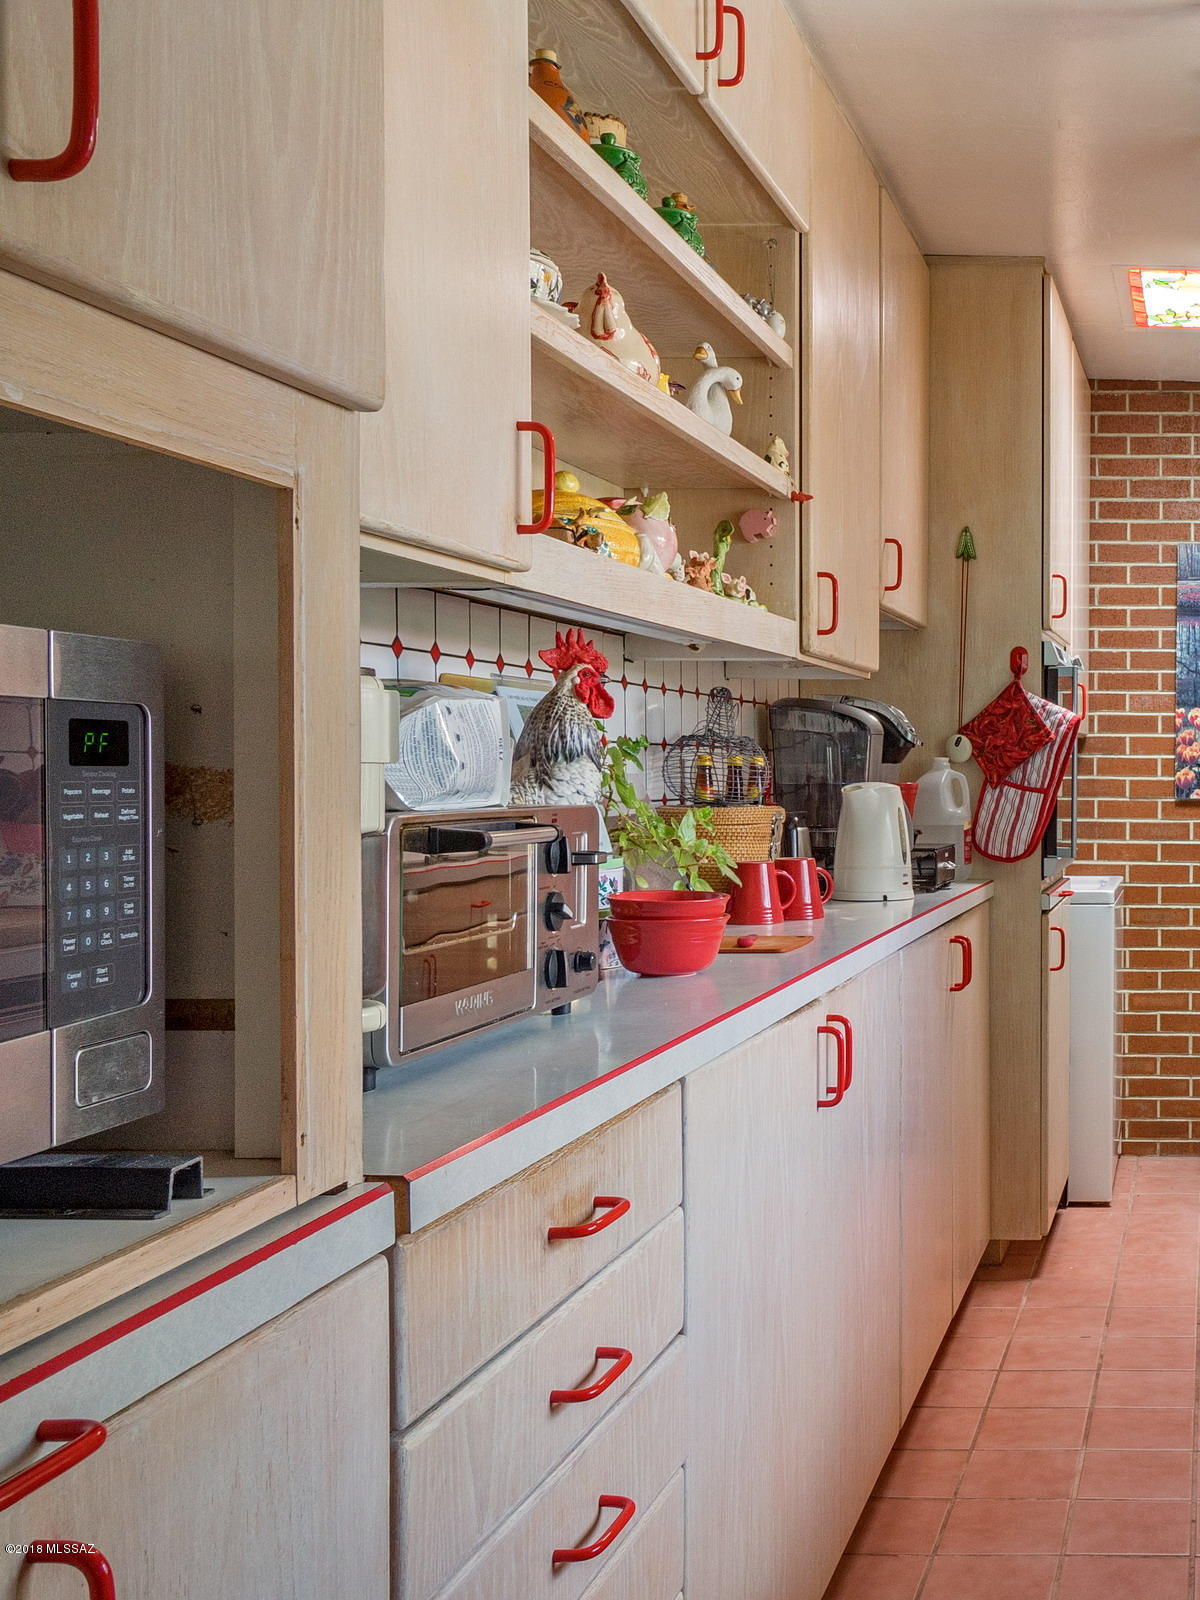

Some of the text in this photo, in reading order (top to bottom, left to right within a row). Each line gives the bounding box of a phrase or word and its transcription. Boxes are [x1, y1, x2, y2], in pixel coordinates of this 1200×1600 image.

[84, 732, 109, 753] PF
[63, 788, 83, 796] Popcorn
[91, 787, 112, 796] Beverage
[67, 854, 72, 864] 1
[85, 852, 91, 862] 2
[104, 851, 109, 861] 3
[66, 883, 72, 892] 4
[85, 881, 91, 890] 5
[104, 879, 109, 888] 6
[66, 911, 72, 920] 7
[86, 908, 91, 918] 8
[104, 907, 109, 916] 9
[85, 937, 91, 946] 0
[63, 944, 76, 952] Level
